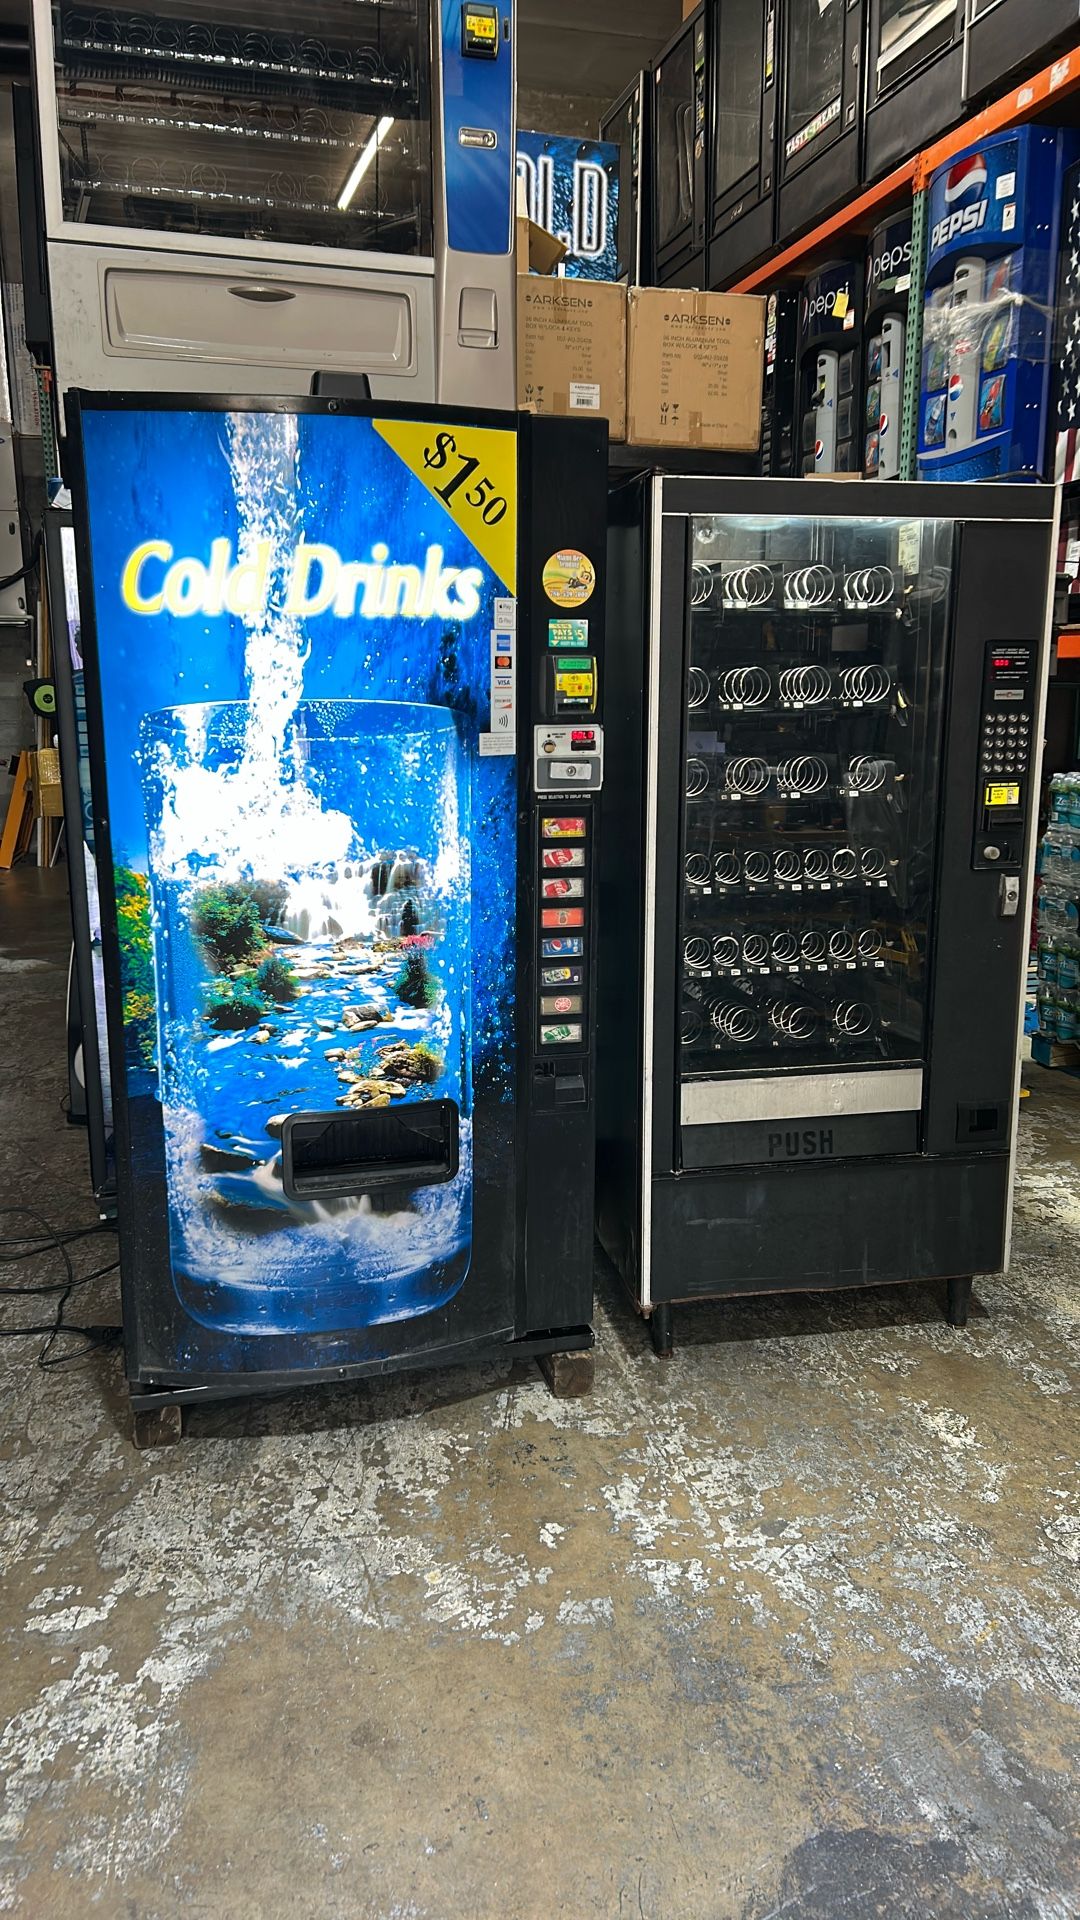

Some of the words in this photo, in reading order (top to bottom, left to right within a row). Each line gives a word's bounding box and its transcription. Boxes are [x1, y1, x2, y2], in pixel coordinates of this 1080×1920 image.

[931, 198, 988, 253] PEPSI
[873, 240, 912, 284] peps
[533, 294, 586, 308] ARKSEN
[671, 314, 724, 326] ARKSEN
[122, 538, 272, 617] Cold
[285, 541, 484, 620] Drinks
[768, 1129, 833, 1157] PUSH
